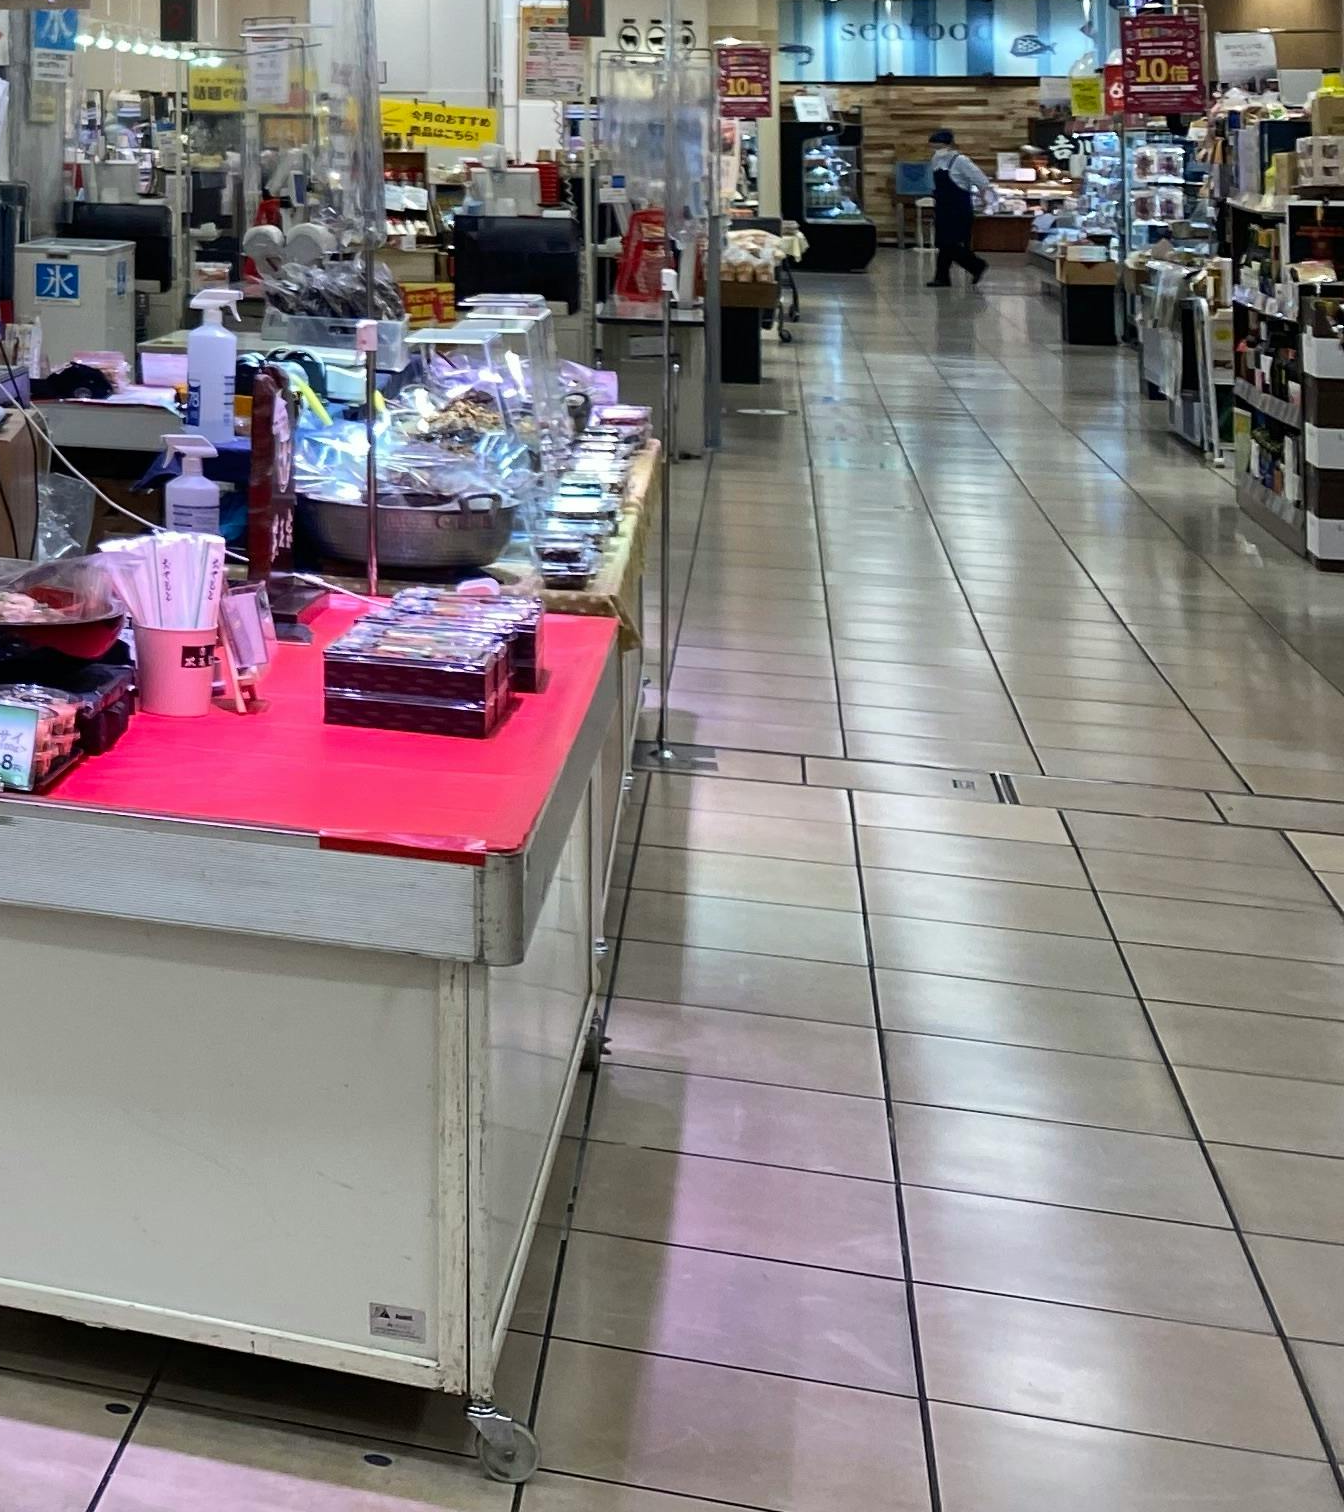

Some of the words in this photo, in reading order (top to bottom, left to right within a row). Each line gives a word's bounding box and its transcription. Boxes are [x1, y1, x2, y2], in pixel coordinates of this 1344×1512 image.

[1135, 58, 1190, 83] 10倍
[412, 110, 491, 127] 今月のおすすめ
[410, 126, 480, 141] 商品はこちら!
[42, 265, 76, 297] 氷
